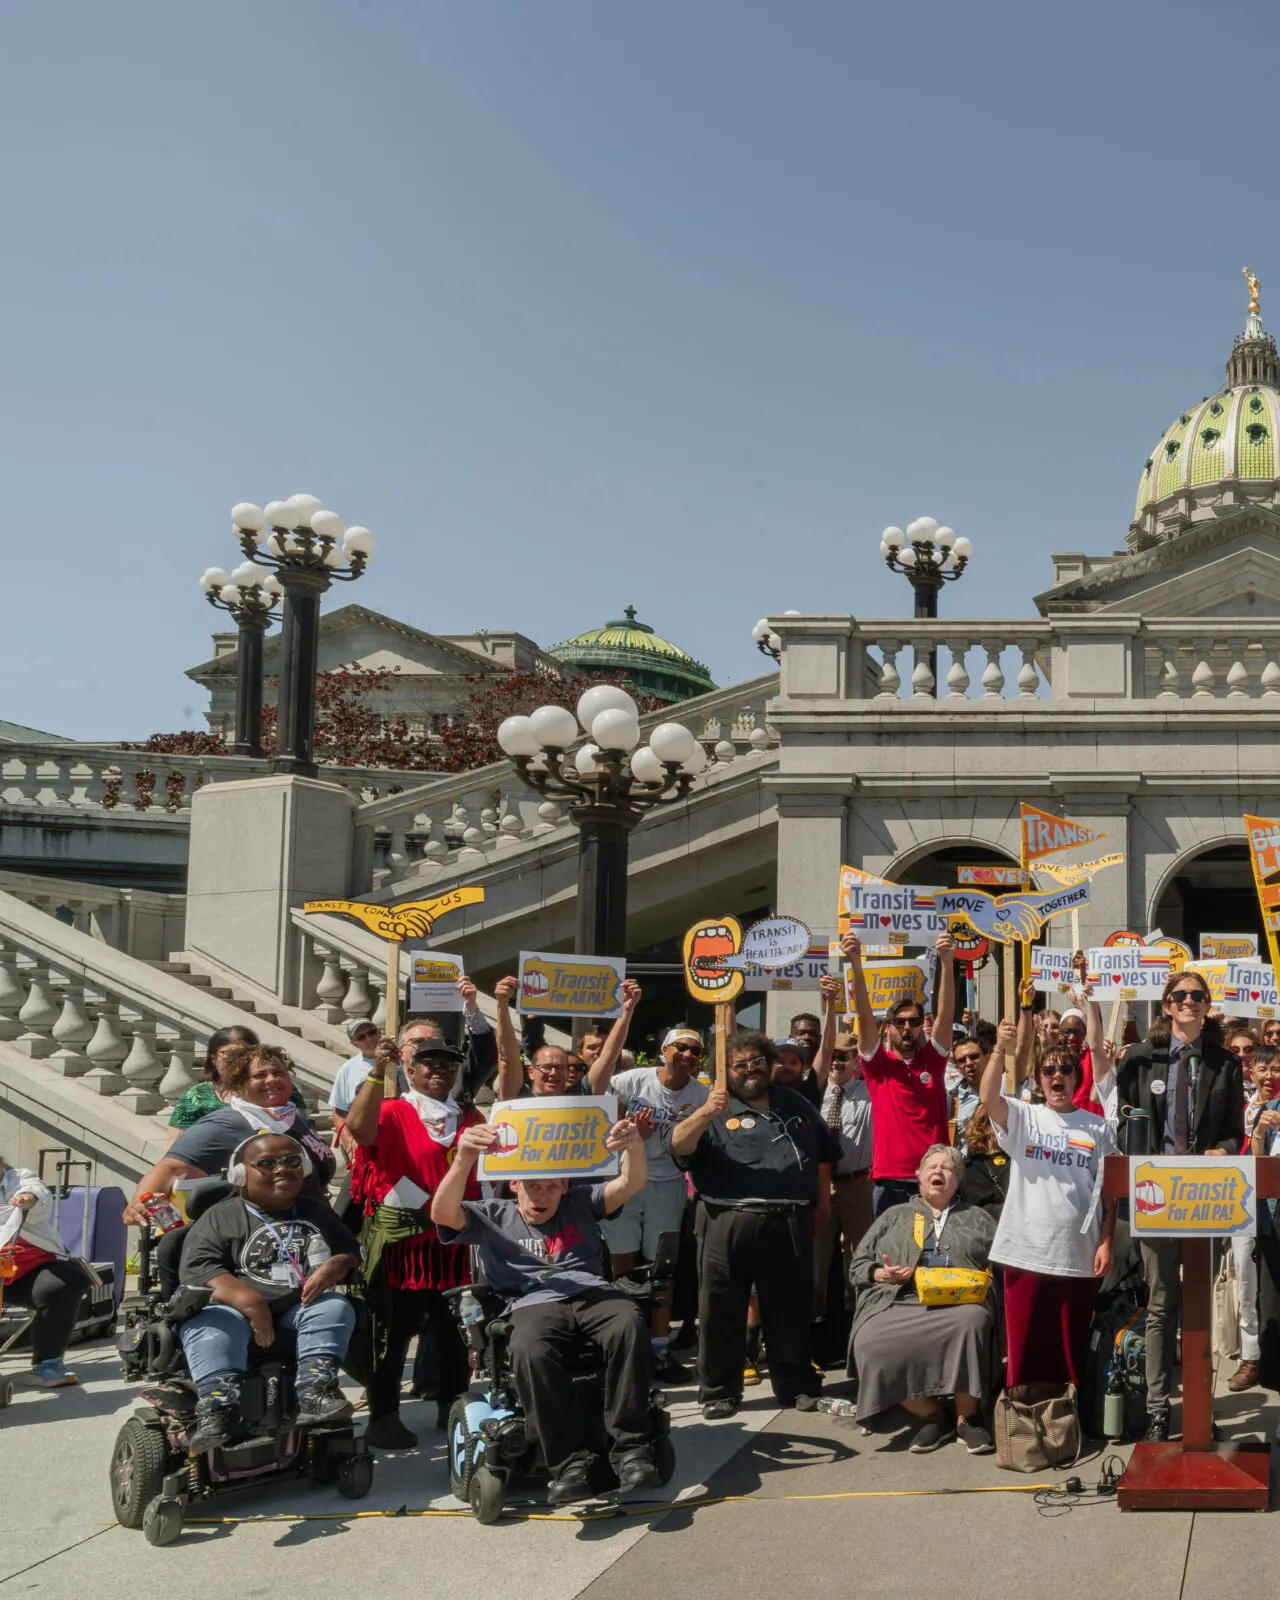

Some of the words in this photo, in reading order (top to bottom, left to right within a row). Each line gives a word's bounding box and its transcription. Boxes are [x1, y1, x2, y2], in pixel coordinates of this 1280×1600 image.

[958, 867, 1029, 884] MVES
[1033, 862, 1064, 874] SAVE
[308, 902, 354, 910] TRANSIT
[441, 892, 462, 906] US
[851, 886, 917, 910] Transit
[942, 895, 986, 913] MOVE
[1036, 888, 1087, 917] TOGETHER
[864, 912, 922, 931] mves
[927, 914, 948, 931] us
[751, 924, 798, 941] TRANSIT
[1033, 948, 1072, 968] Transi
[1218, 942, 1250, 955] Transit
[1090, 949, 1143, 969] Transit
[554, 969, 610, 990] Transit
[752, 962, 804, 978] mves
[808, 962, 829, 978] us
[1040, 967, 1080, 983] mve
[1099, 971, 1148, 987] mves
[1228, 963, 1275, 987] Transi
[872, 971, 918, 990] Transit
[550, 989, 567, 1003] For
[569, 990, 587, 1004] All
[588, 991, 607, 1006] PA!
[872, 991, 887, 1004] For
[888, 990, 901, 1002] All
[1237, 987, 1280, 1006] mve
[525, 1115, 600, 1142] Transit
[520, 1144, 545, 1162] For
[550, 1143, 568, 1161] All
[570, 1142, 595, 1161] PA!
[1031, 1145, 1074, 1167] mves
[1077, 1154, 1092, 1169] us
[1168, 1175, 1240, 1202] Transit
[1168, 1203, 1190, 1221] For
[1191, 1202, 1210, 1221] All
[1212, 1202, 1234, 1221] PA!
